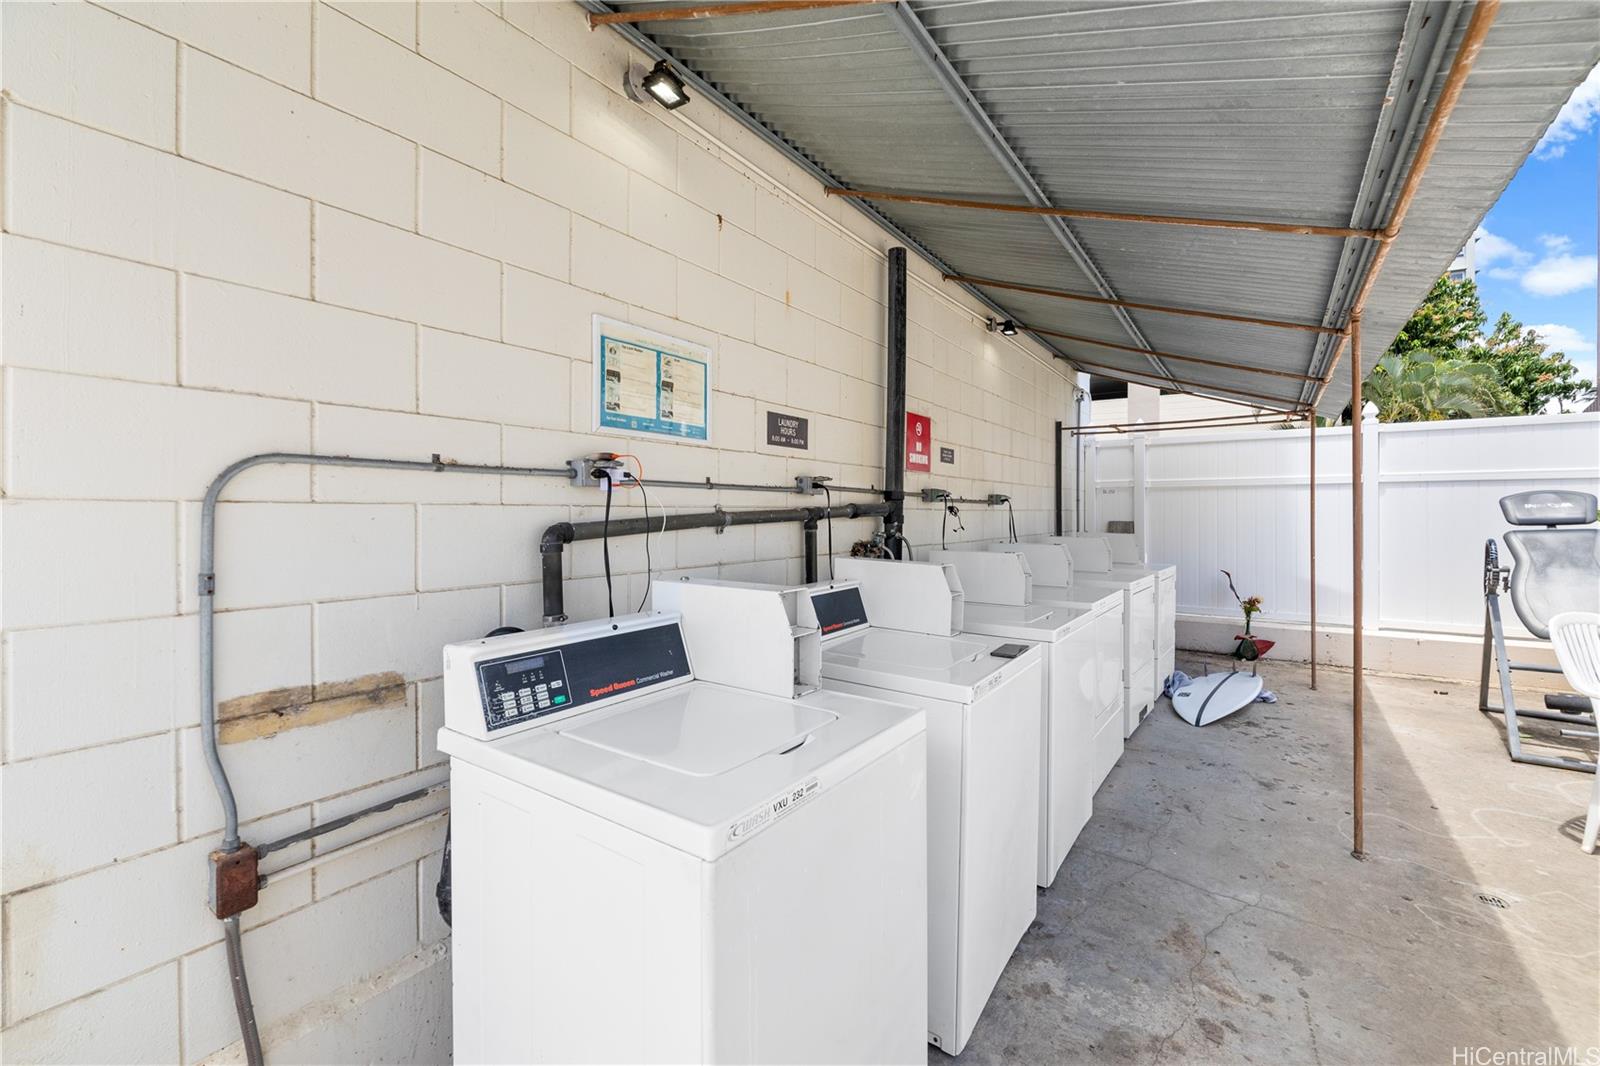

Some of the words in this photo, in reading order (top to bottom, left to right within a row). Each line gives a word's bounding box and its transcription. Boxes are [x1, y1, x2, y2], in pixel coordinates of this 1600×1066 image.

[777, 417, 799, 429] LAUNDRY
[780, 426, 797, 437] HOURS
[590, 684, 613, 697] Speed
[613, 679, 636, 690] Queen
[636, 673, 660, 684] Commercial
[773, 797, 788, 812] VXU
[792, 788, 804, 802] 232
